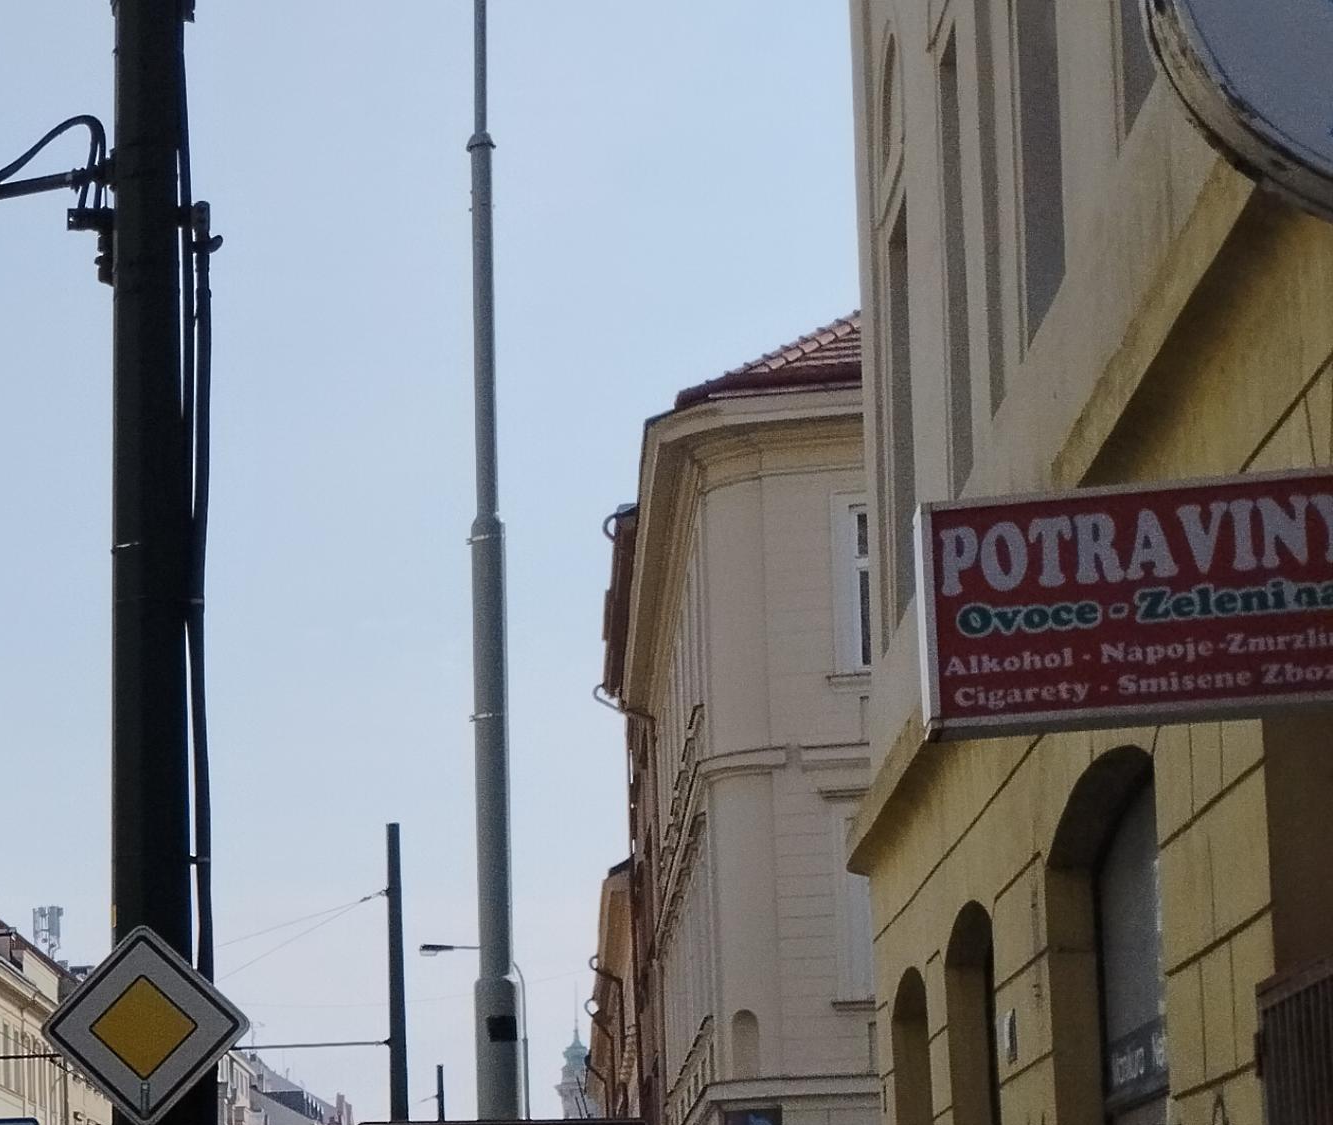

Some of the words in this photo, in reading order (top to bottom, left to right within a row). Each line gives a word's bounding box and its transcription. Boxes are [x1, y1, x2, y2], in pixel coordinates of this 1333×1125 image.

[957, 603, 1102, 638] Ovoce
[944, 648, 1073, 676] Alkohol
[1100, 638, 1213, 665] Napoje
[954, 680, 1089, 708] Cigarety
[1117, 668, 1252, 695] Smisene
